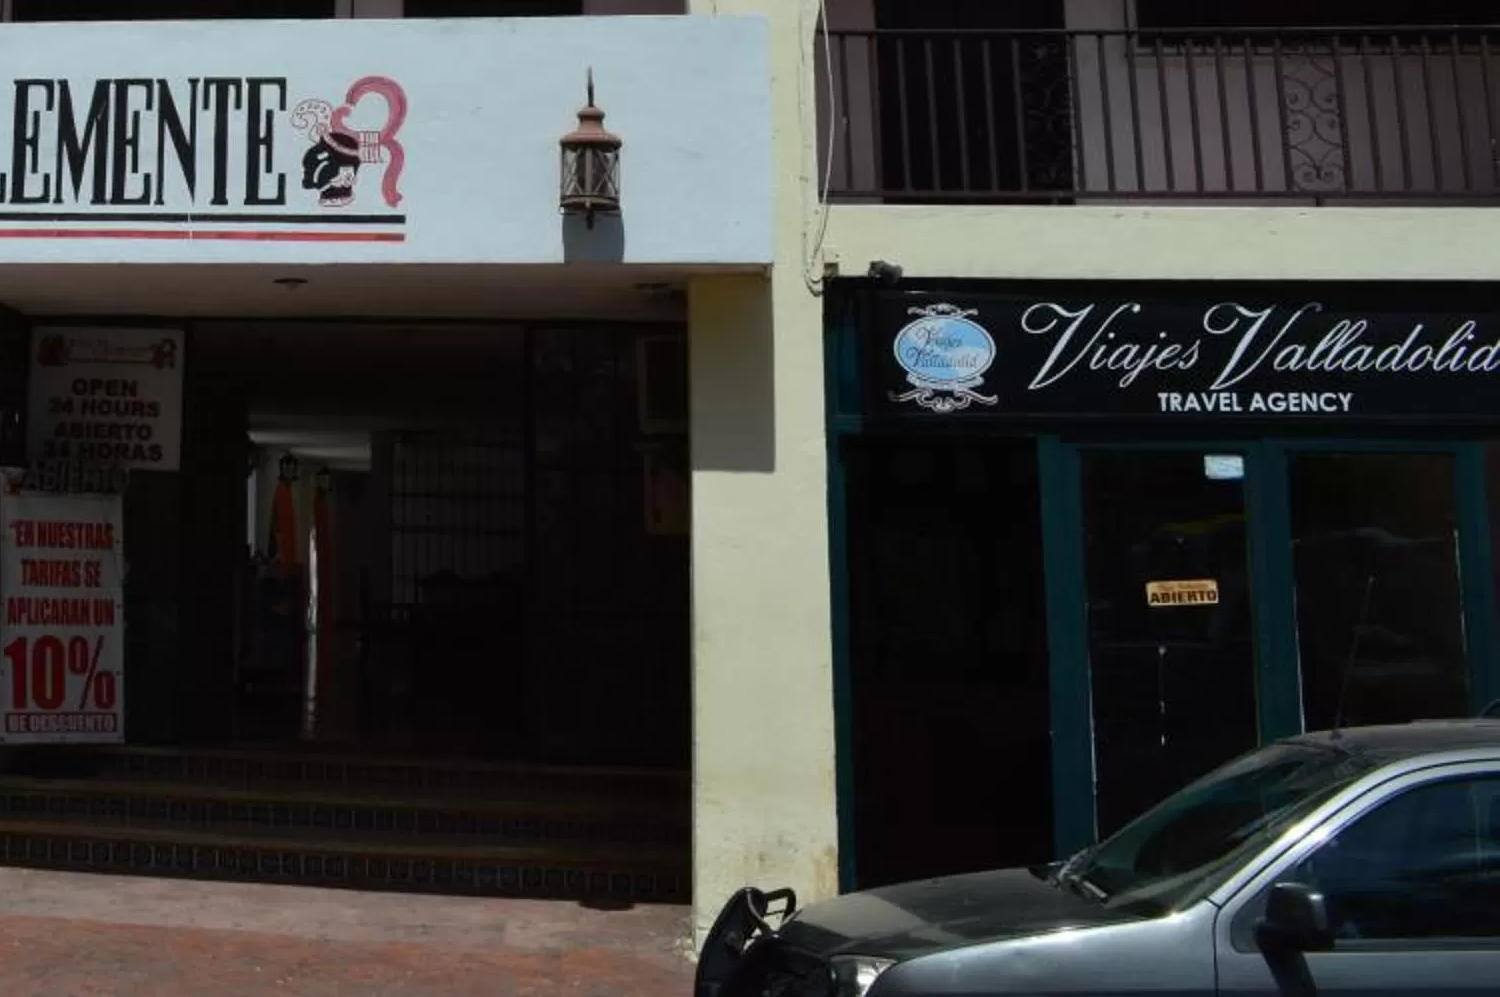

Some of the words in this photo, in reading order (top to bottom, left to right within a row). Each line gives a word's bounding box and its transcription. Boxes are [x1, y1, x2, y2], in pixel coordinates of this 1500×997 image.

[1021, 302, 1201, 390] Viajes
[1203, 302, 1500, 390] Valladolid
[71, 378, 138, 397] OPEN
[80, 399, 161, 418] HOURS
[1157, 392, 1243, 412] TRAVEL
[1249, 392, 1353, 413] AGENCY
[54, 422, 153, 441] ABIERTO
[78, 442, 163, 462] HORAS
[37, 522, 114, 550] NUESTRAS
[21, 559, 81, 587] TARIFAS
[1151, 590, 1217, 604] ABIERTO
[3, 634, 116, 710] 10%
